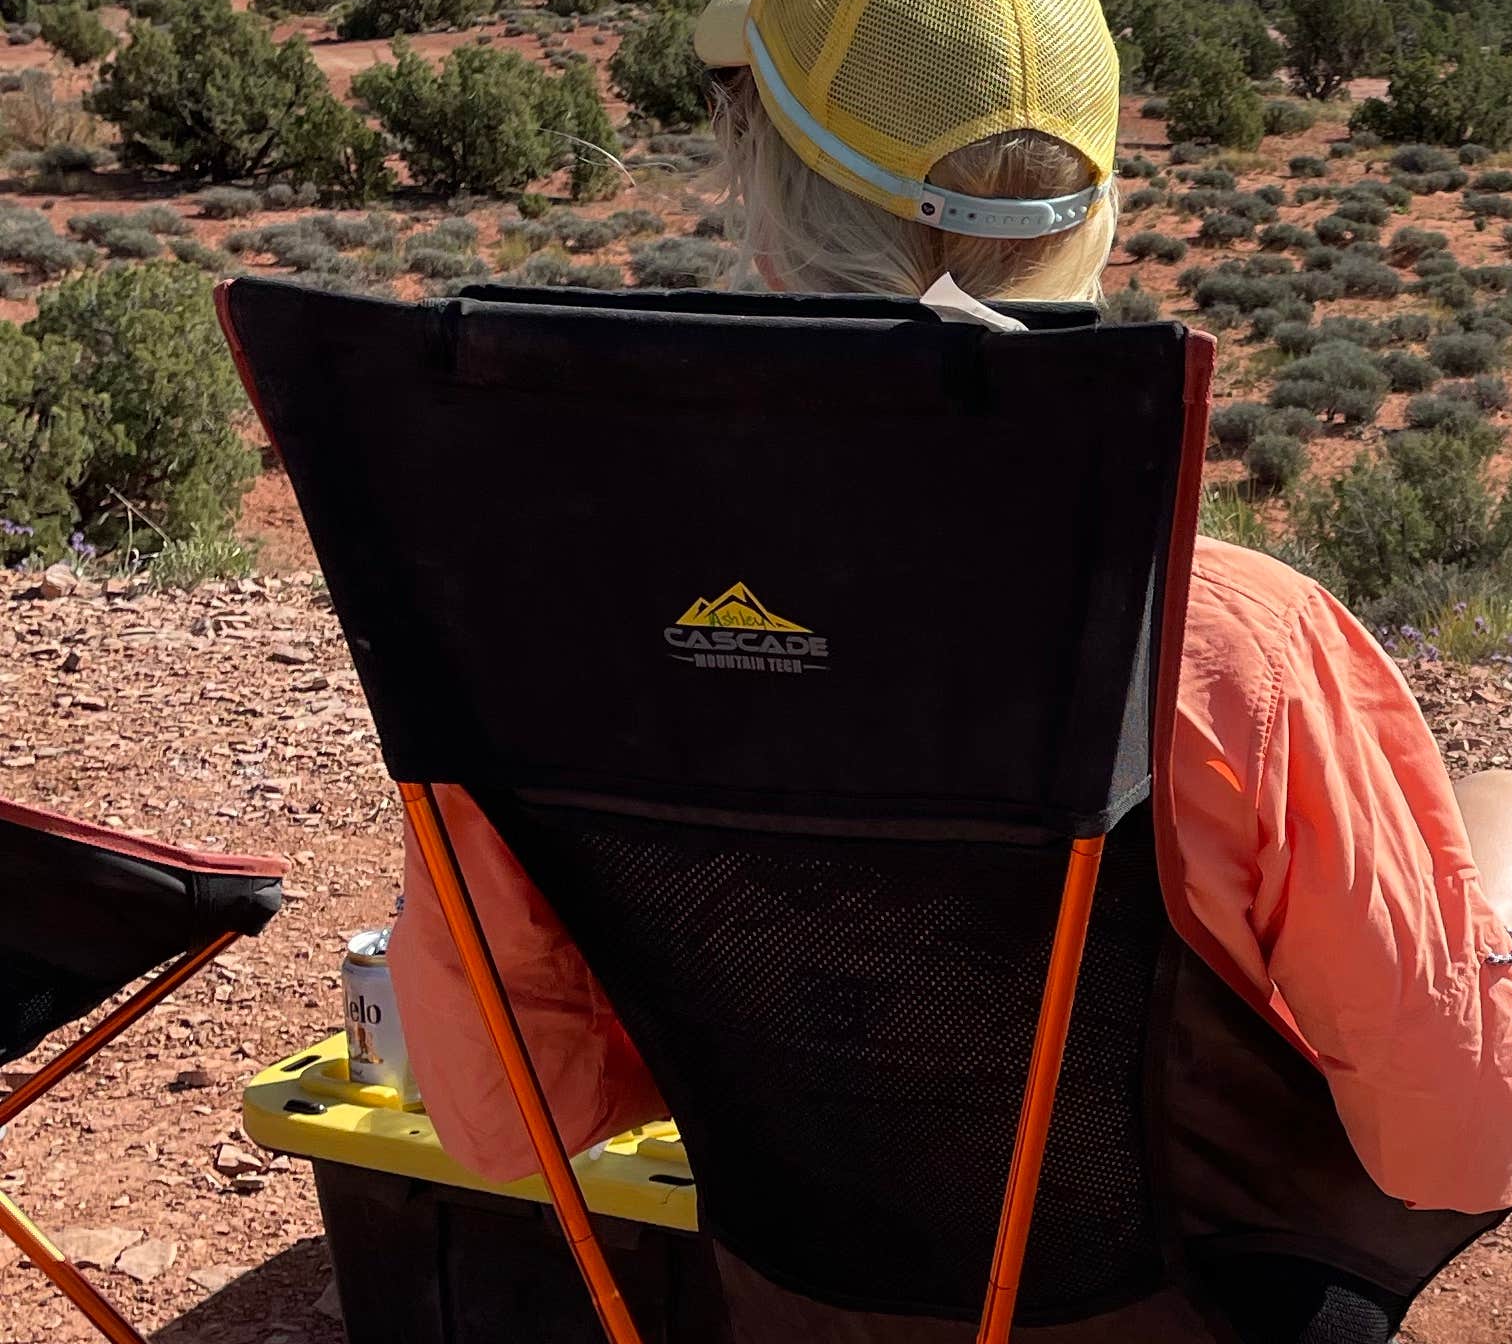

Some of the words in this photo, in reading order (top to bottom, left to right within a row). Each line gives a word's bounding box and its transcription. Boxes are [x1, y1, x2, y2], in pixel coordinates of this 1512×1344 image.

[709, 611, 767, 630] Ashley
[664, 627, 830, 657] CASCADE
[694, 653, 765, 672] MOUNTAIN
[767, 657, 803, 674] TECH
